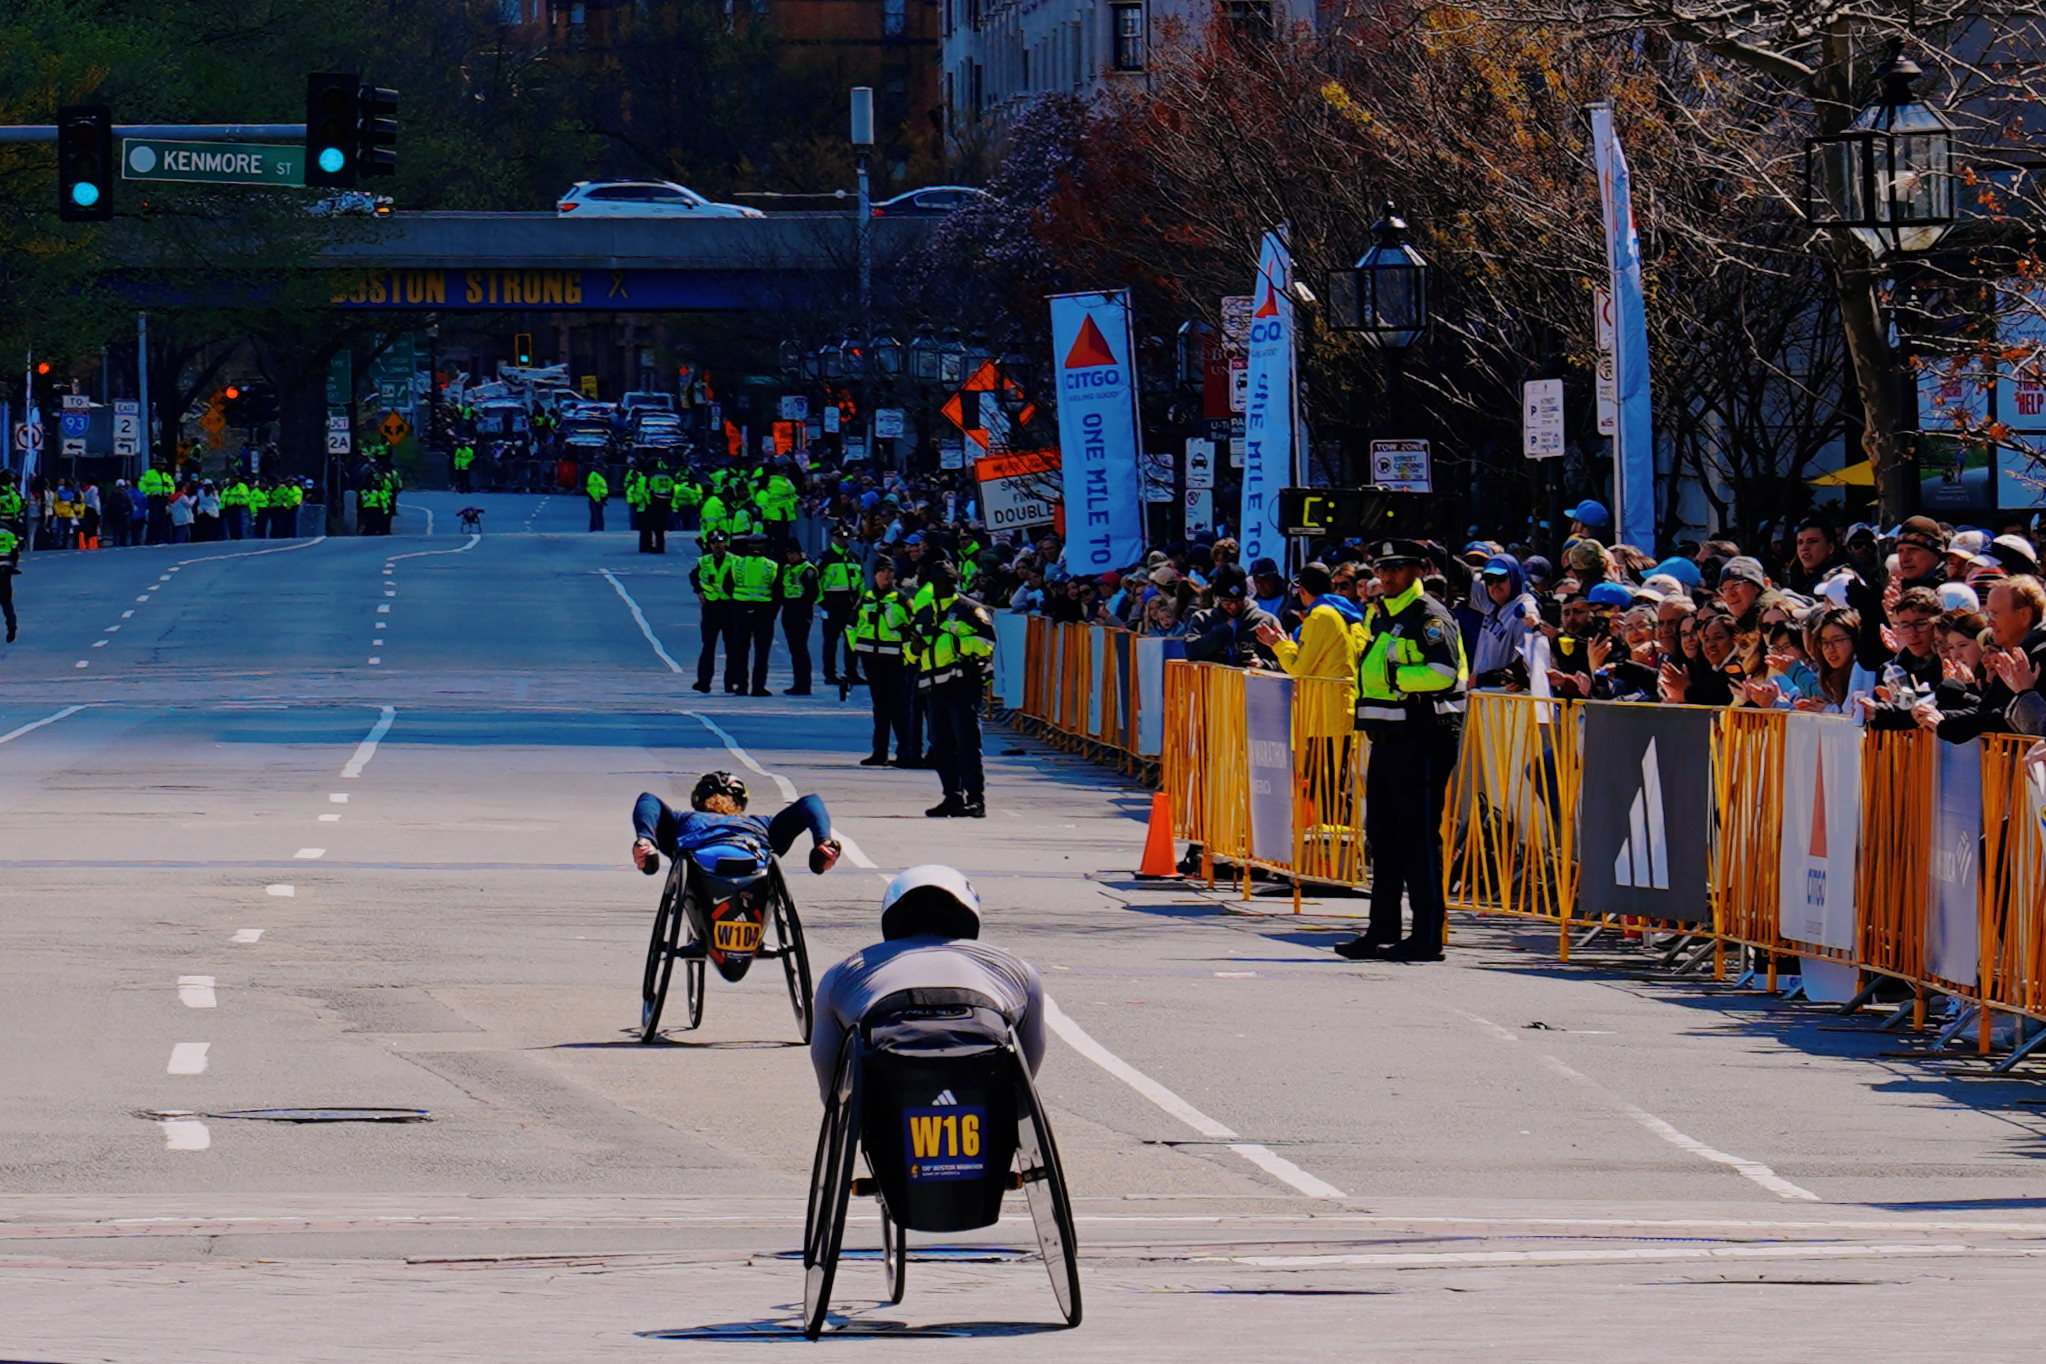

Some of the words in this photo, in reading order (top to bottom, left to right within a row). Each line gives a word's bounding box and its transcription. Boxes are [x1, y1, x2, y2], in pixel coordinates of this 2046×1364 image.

[163, 150, 263, 175] KENMORE
[276, 161, 293, 176] ST
[465, 268, 583, 304] STRONG
[1066, 369, 1120, 390] CITGO
[69, 397, 83, 406] TO
[2017, 392, 2044, 416] HELP
[65, 416, 86, 431] 93
[121, 419, 132, 433] 2
[330, 417, 348, 428] JCT
[329, 436, 349, 449] 2A
[1082, 412, 1106, 462] ONE
[1247, 440, 1264, 511] MILE
[1086, 467, 1110, 527] MILE
[994, 502, 1055, 524] DOUBLE
[1089, 533, 1112, 565] TO
[1246, 521, 1262, 559] TO
[909, 1113, 981, 1159] W16
